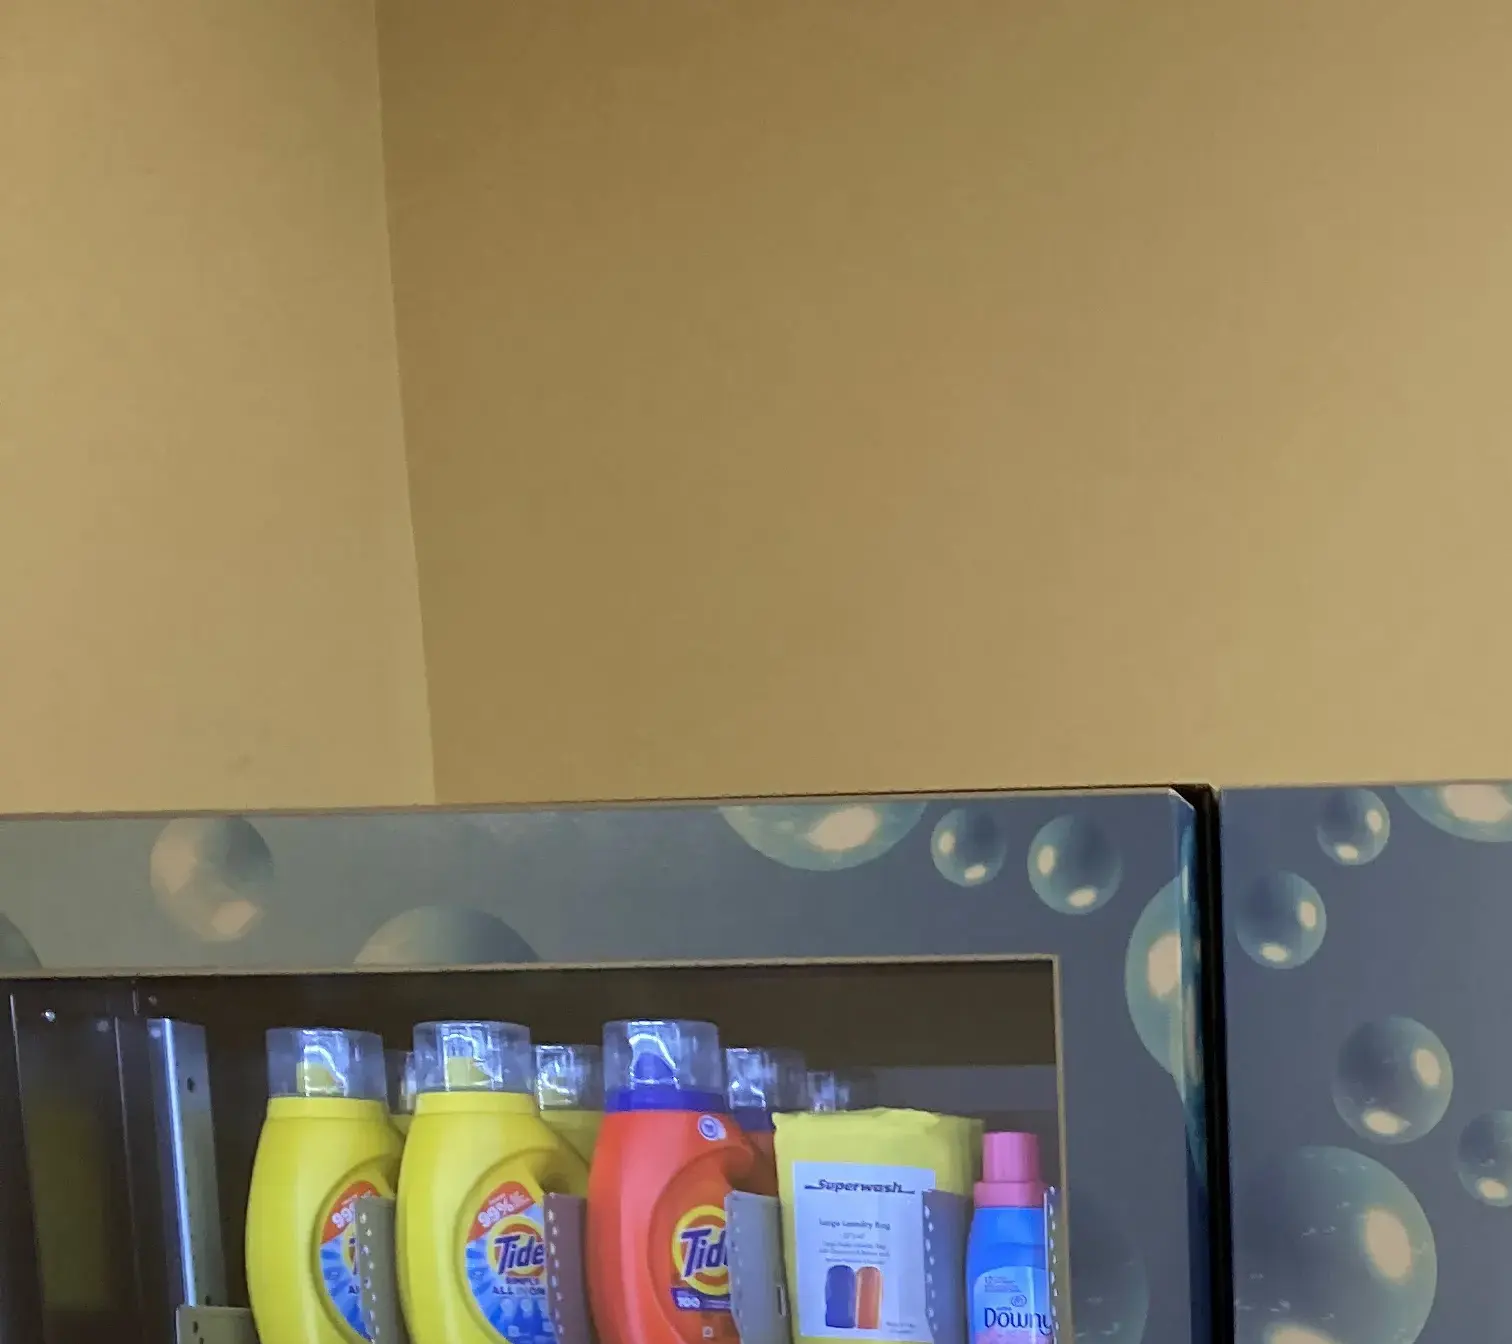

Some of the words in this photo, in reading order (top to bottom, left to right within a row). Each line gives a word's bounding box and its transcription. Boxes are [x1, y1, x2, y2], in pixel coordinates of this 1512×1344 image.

[805, 1179, 915, 1195] Superwash
[495, 1234, 545, 1275] Tide
[681, 1228, 729, 1278] Tid
[984, 1307, 1053, 1336] Downy
